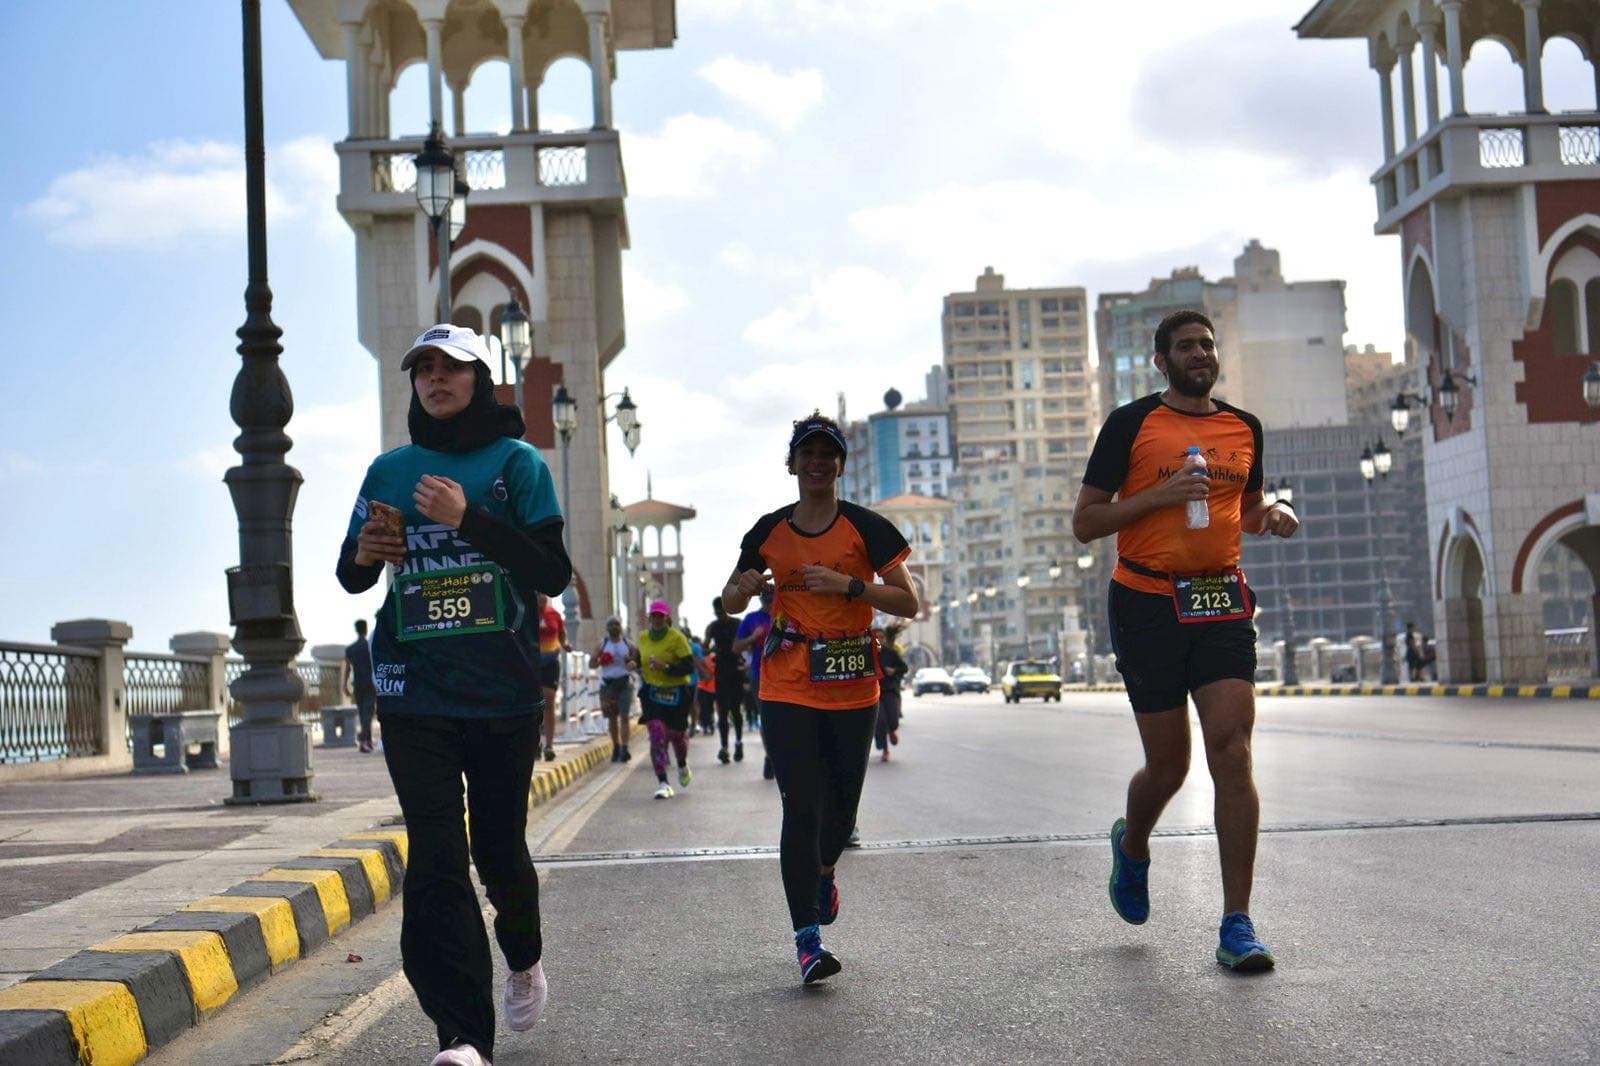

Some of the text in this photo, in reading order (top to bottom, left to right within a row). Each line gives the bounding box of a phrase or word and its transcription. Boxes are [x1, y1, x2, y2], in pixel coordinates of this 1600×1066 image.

[441, 575, 470, 587] Half
[422, 588, 471, 598] Marathon
[1191, 591, 1232, 610] 2123
[428, 596, 472, 621] 559
[376, 663, 406, 674] GET OUT
[825, 654, 865, 673] 2189
[375, 678, 406, 693] RUN
